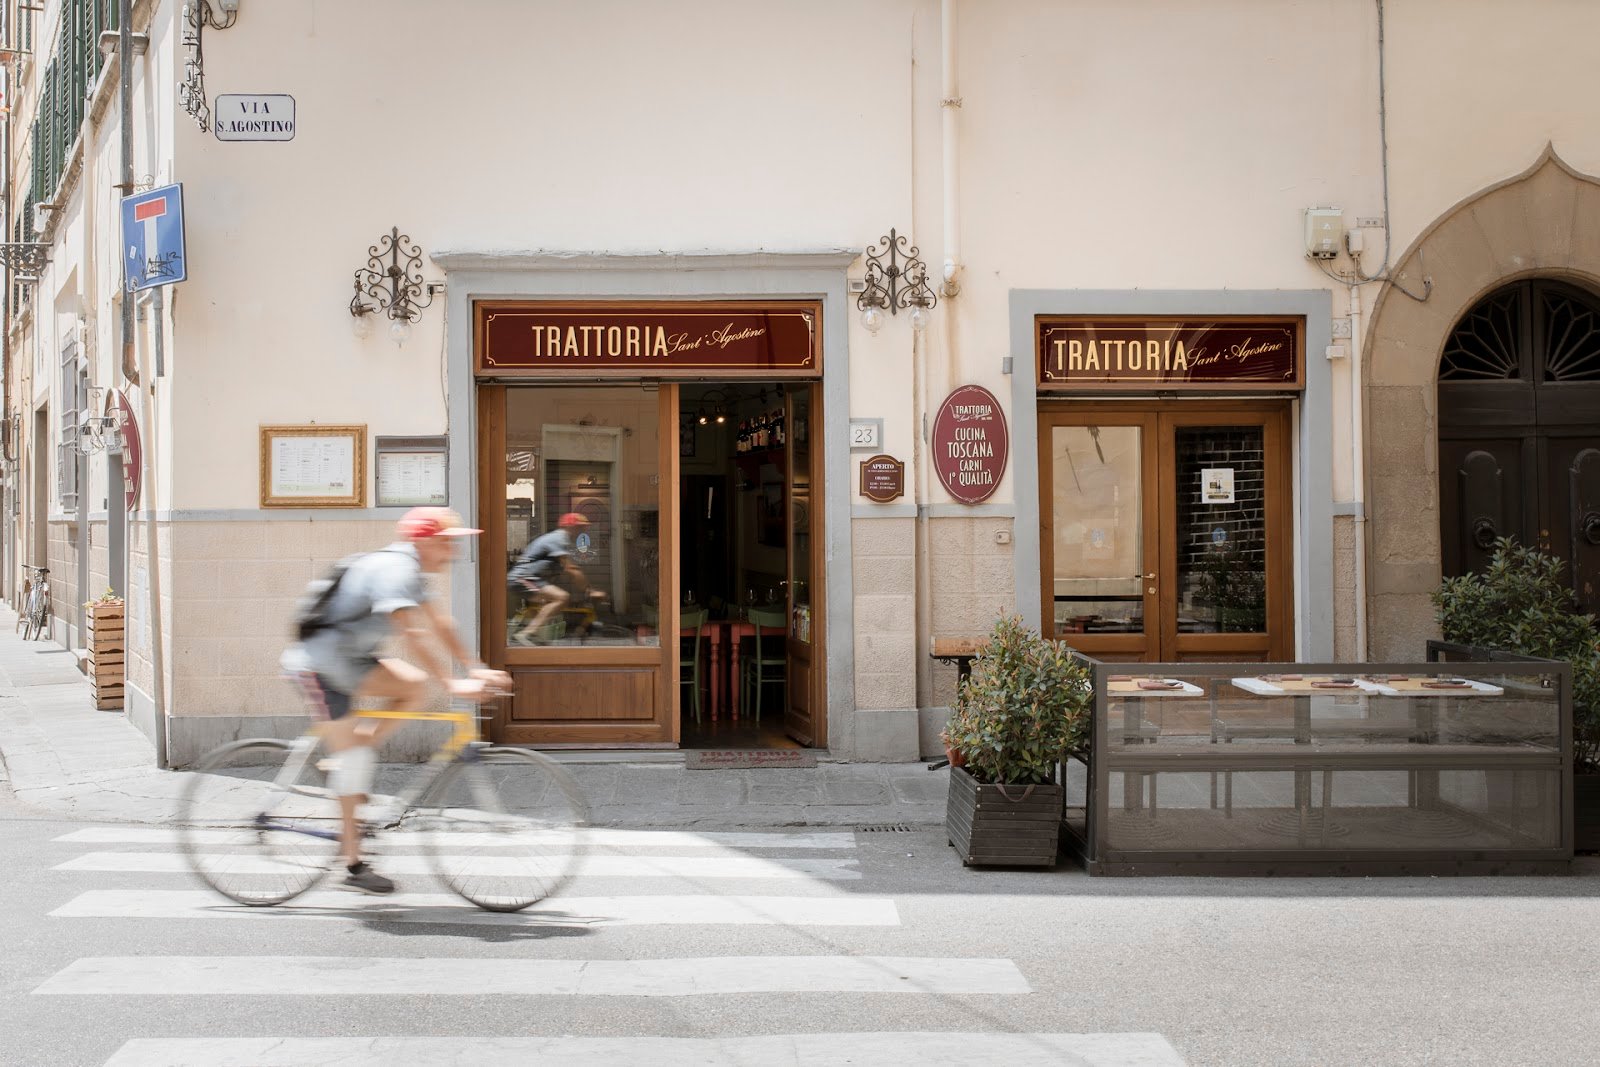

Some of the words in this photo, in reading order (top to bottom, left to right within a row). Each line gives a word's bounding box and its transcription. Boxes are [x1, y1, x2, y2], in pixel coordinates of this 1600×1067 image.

[240, 102, 270, 114] VIA
[532, 325, 668, 357] TRATTORIA
[1053, 340, 1188, 371] TRATTORIA
[955, 404, 992, 415] TRATTORIA
[855, 428, 873, 443] 23
[954, 427, 986, 441] CUCINA
[947, 441, 994, 458] TOSCANA
[959, 459, 983, 471] CARNI
[958, 469, 993, 486] QUALITÀ
